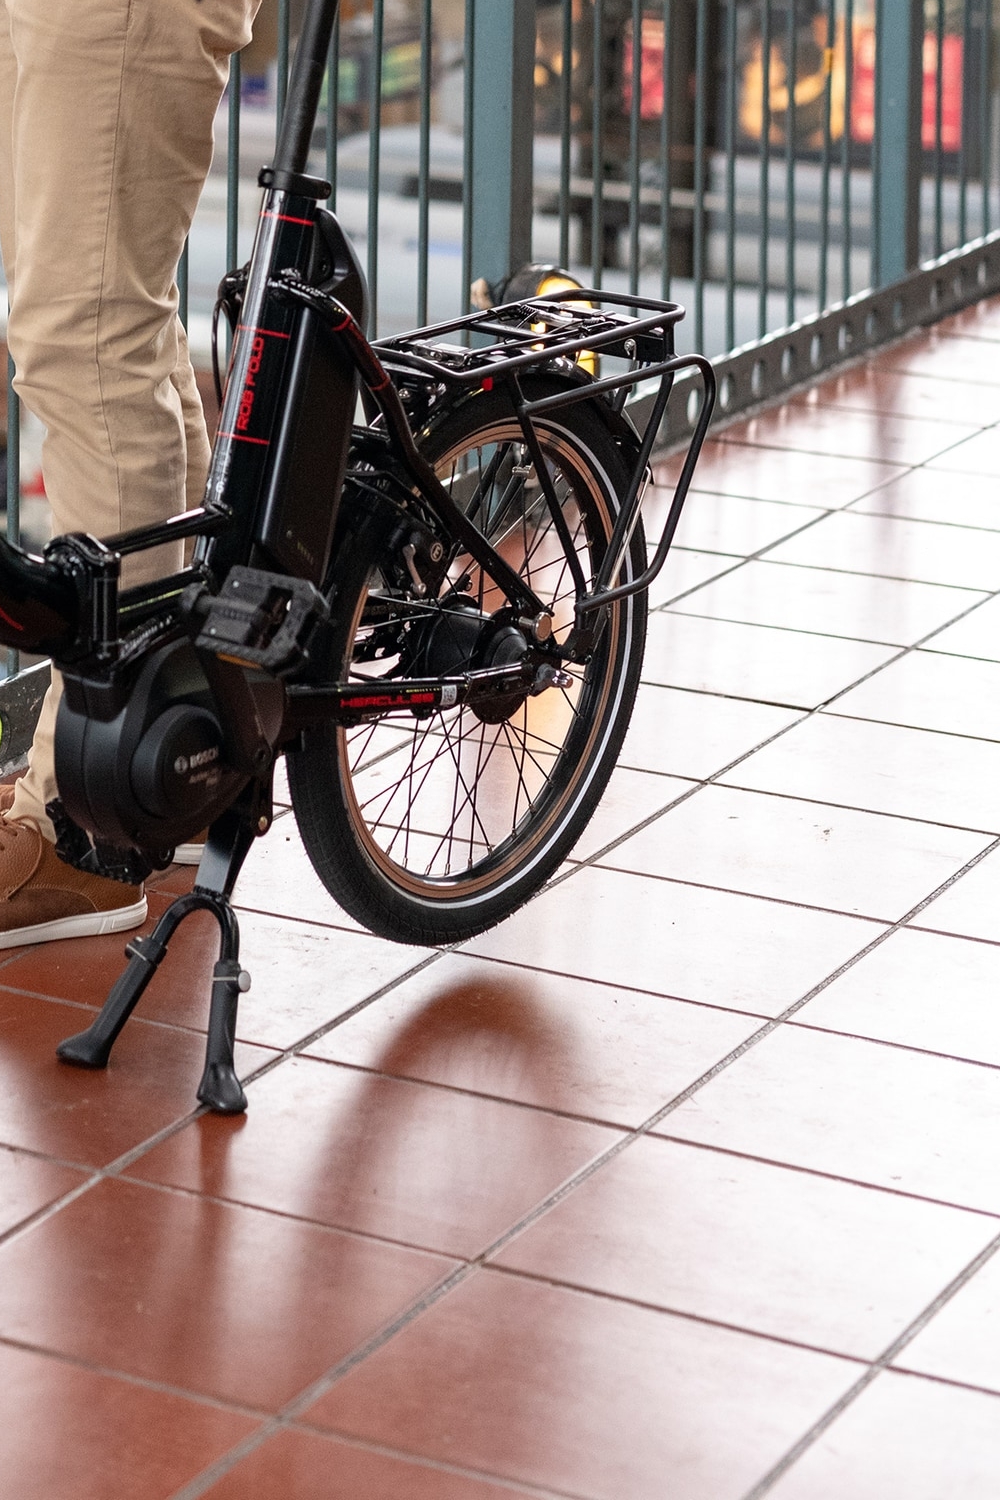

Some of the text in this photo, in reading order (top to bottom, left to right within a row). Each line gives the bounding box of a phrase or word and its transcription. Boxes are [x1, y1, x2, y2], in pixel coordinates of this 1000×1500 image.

[236, 336, 264, 431] ROB FOLD
[340, 693, 434, 708] HERCULES
